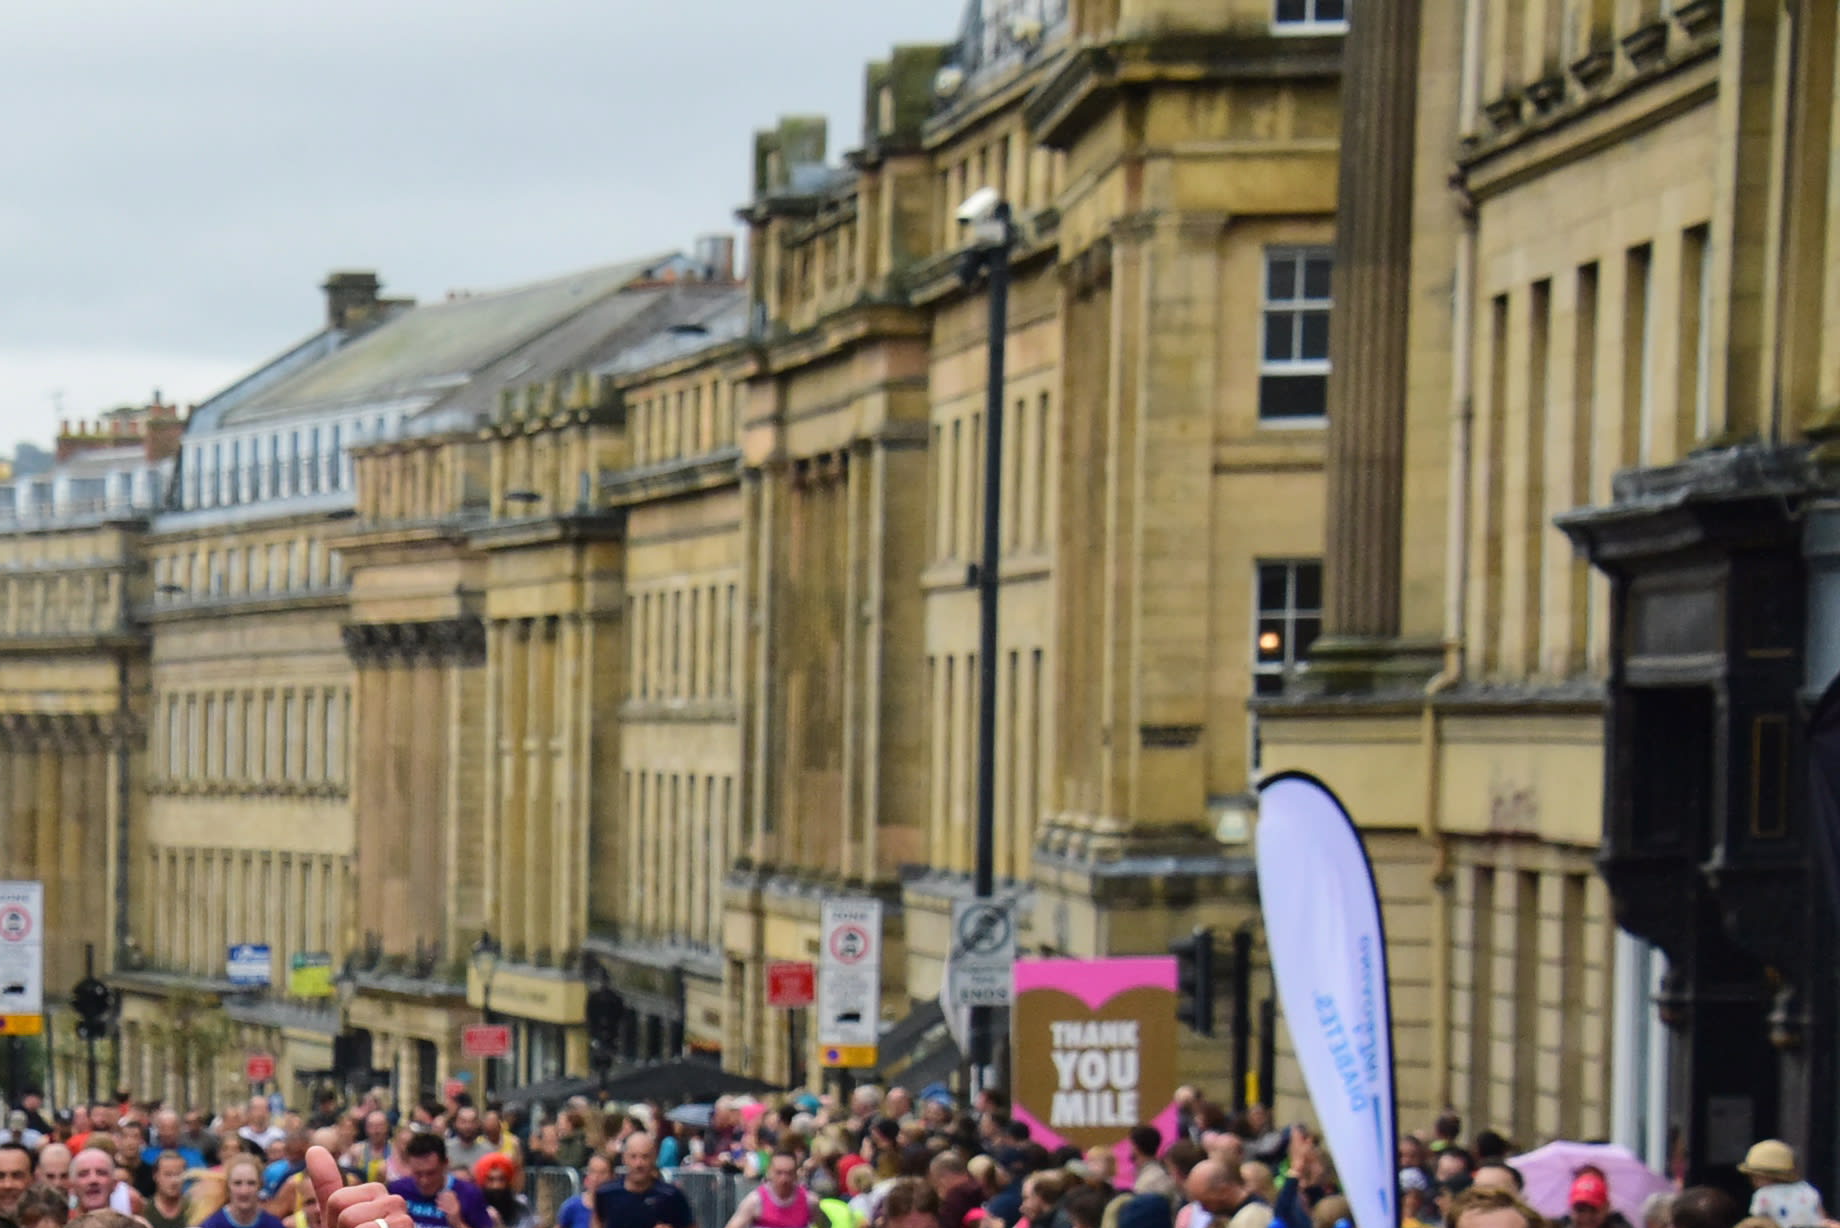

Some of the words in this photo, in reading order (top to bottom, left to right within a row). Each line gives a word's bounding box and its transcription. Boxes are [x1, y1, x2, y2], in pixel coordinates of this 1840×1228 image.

[1049, 1020, 1140, 1048] THANK
[1049, 1048, 1139, 1090] YOU
[1049, 1090, 1139, 1128] MILE
